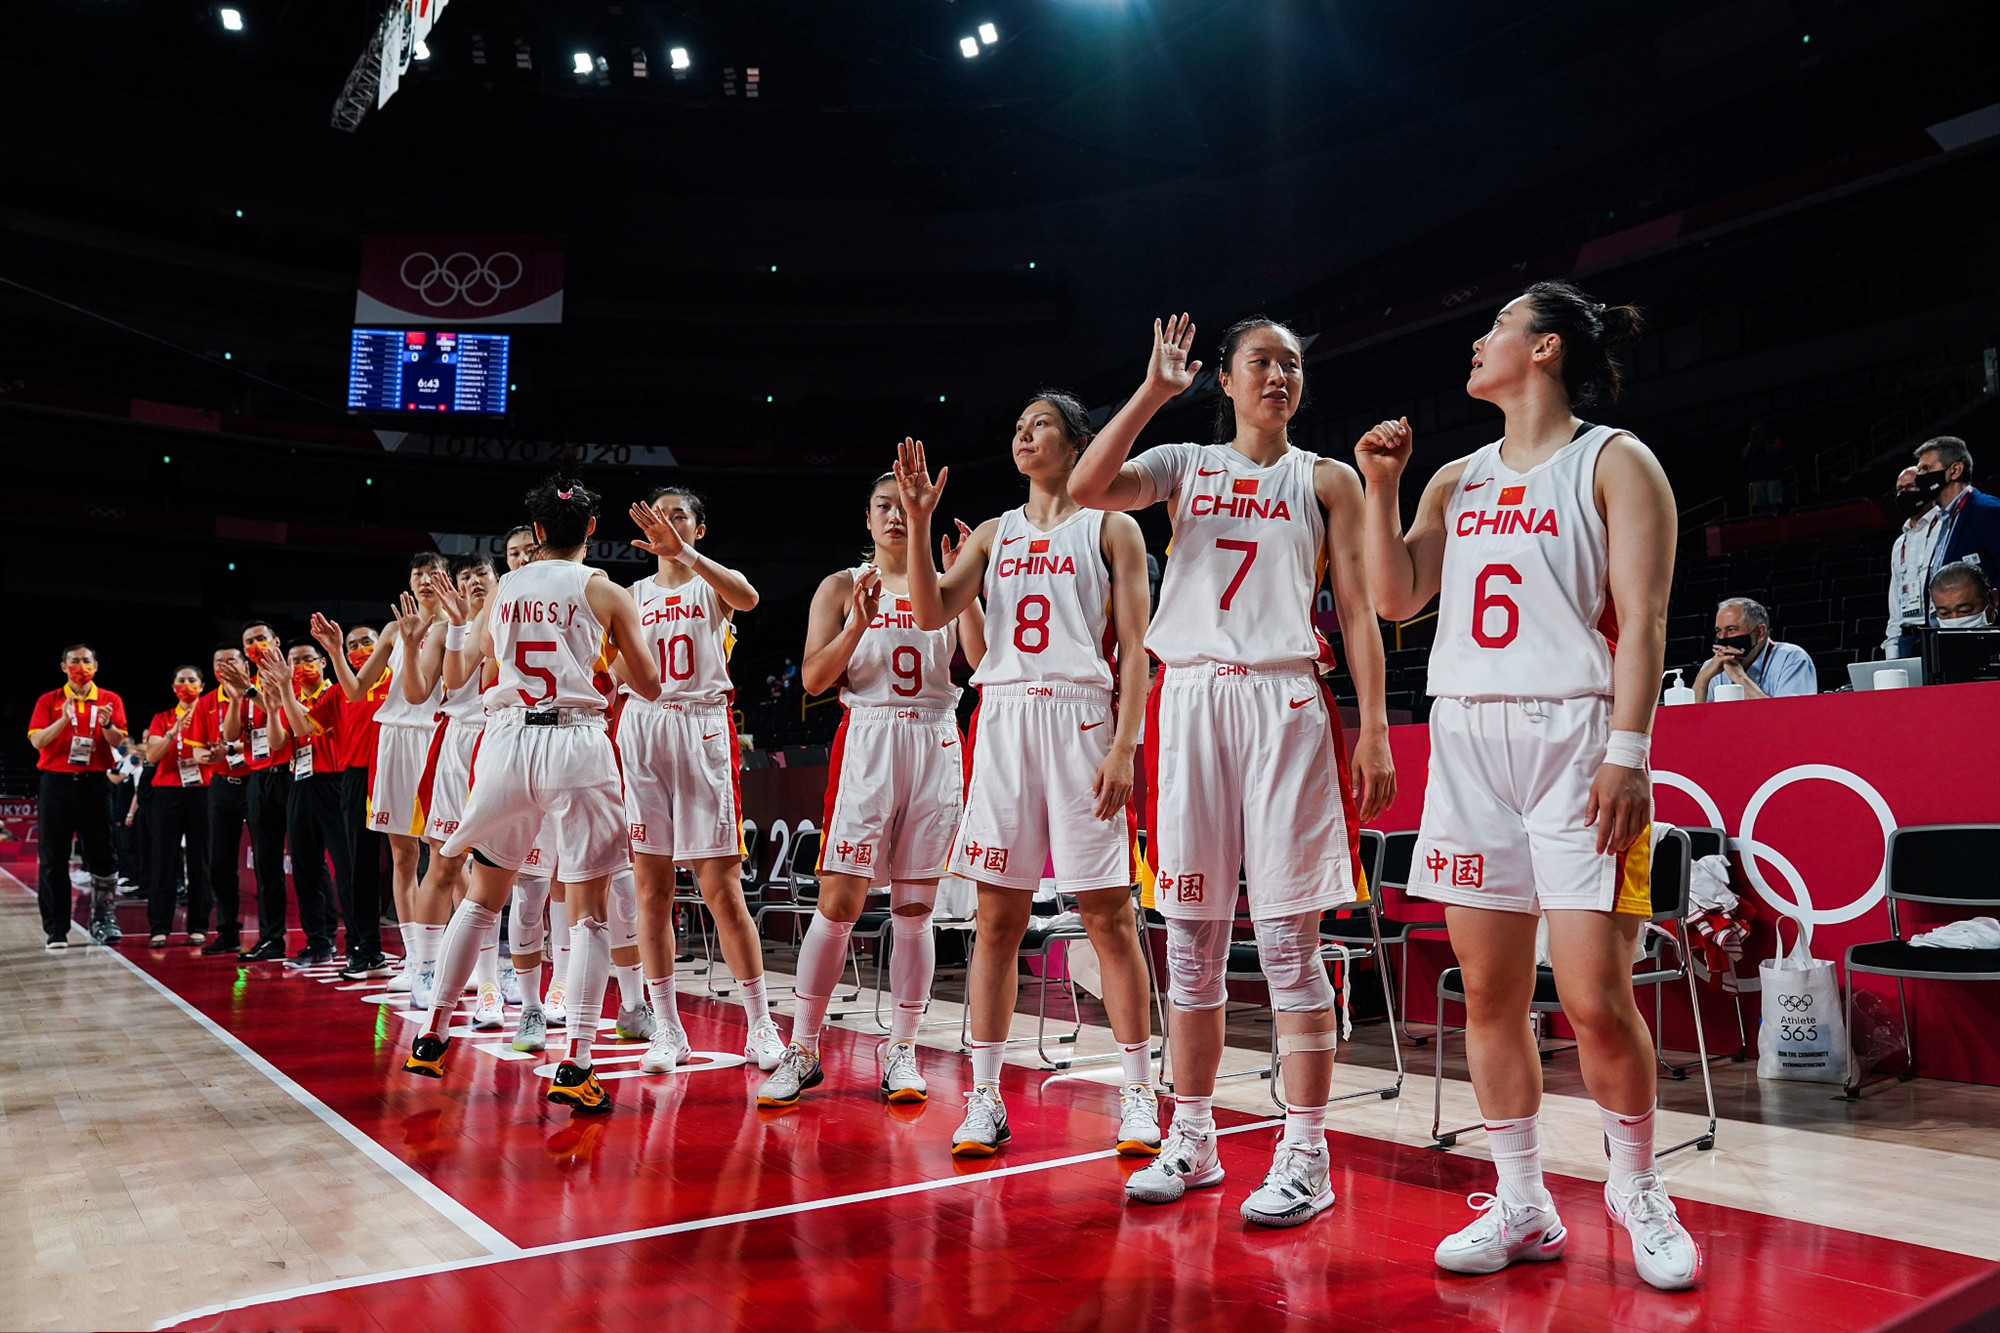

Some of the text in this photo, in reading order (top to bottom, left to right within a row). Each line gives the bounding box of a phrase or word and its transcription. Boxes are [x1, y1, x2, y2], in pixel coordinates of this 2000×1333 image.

[411, 352, 449, 363] 0 0
[417, 378, 440, 389] 6:43
[424, 434, 538, 460] TOKYO
[1191, 494, 1292, 522] CHINA
[1456, 508, 1559, 537] CHINA
[998, 556, 1076, 578] CHINA
[1216, 538, 1259, 611] 7
[641, 605, 706, 627] CHINA
[1471, 563, 1522, 649] 6
[1013, 594, 1051, 655] 8
[656, 634, 695, 684] 10
[892, 646, 923, 697] 9
[1216, 665, 1248, 677] CHN
[514, 641, 557, 707] 5
[1027, 687, 1053, 697] CHN
[662, 703, 683, 711] CHN
[898, 711, 919, 719] CHN
[433, 817, 460, 835] 中国
[836, 840, 872, 866] 中国
[965, 840, 1009, 874] 中国
[1426, 848, 1484, 889] 中国
[1159, 870, 1205, 903] 中国
[1780, 1016, 1817, 1025] Athlete
[1780, 1025, 1818, 1042] 365
